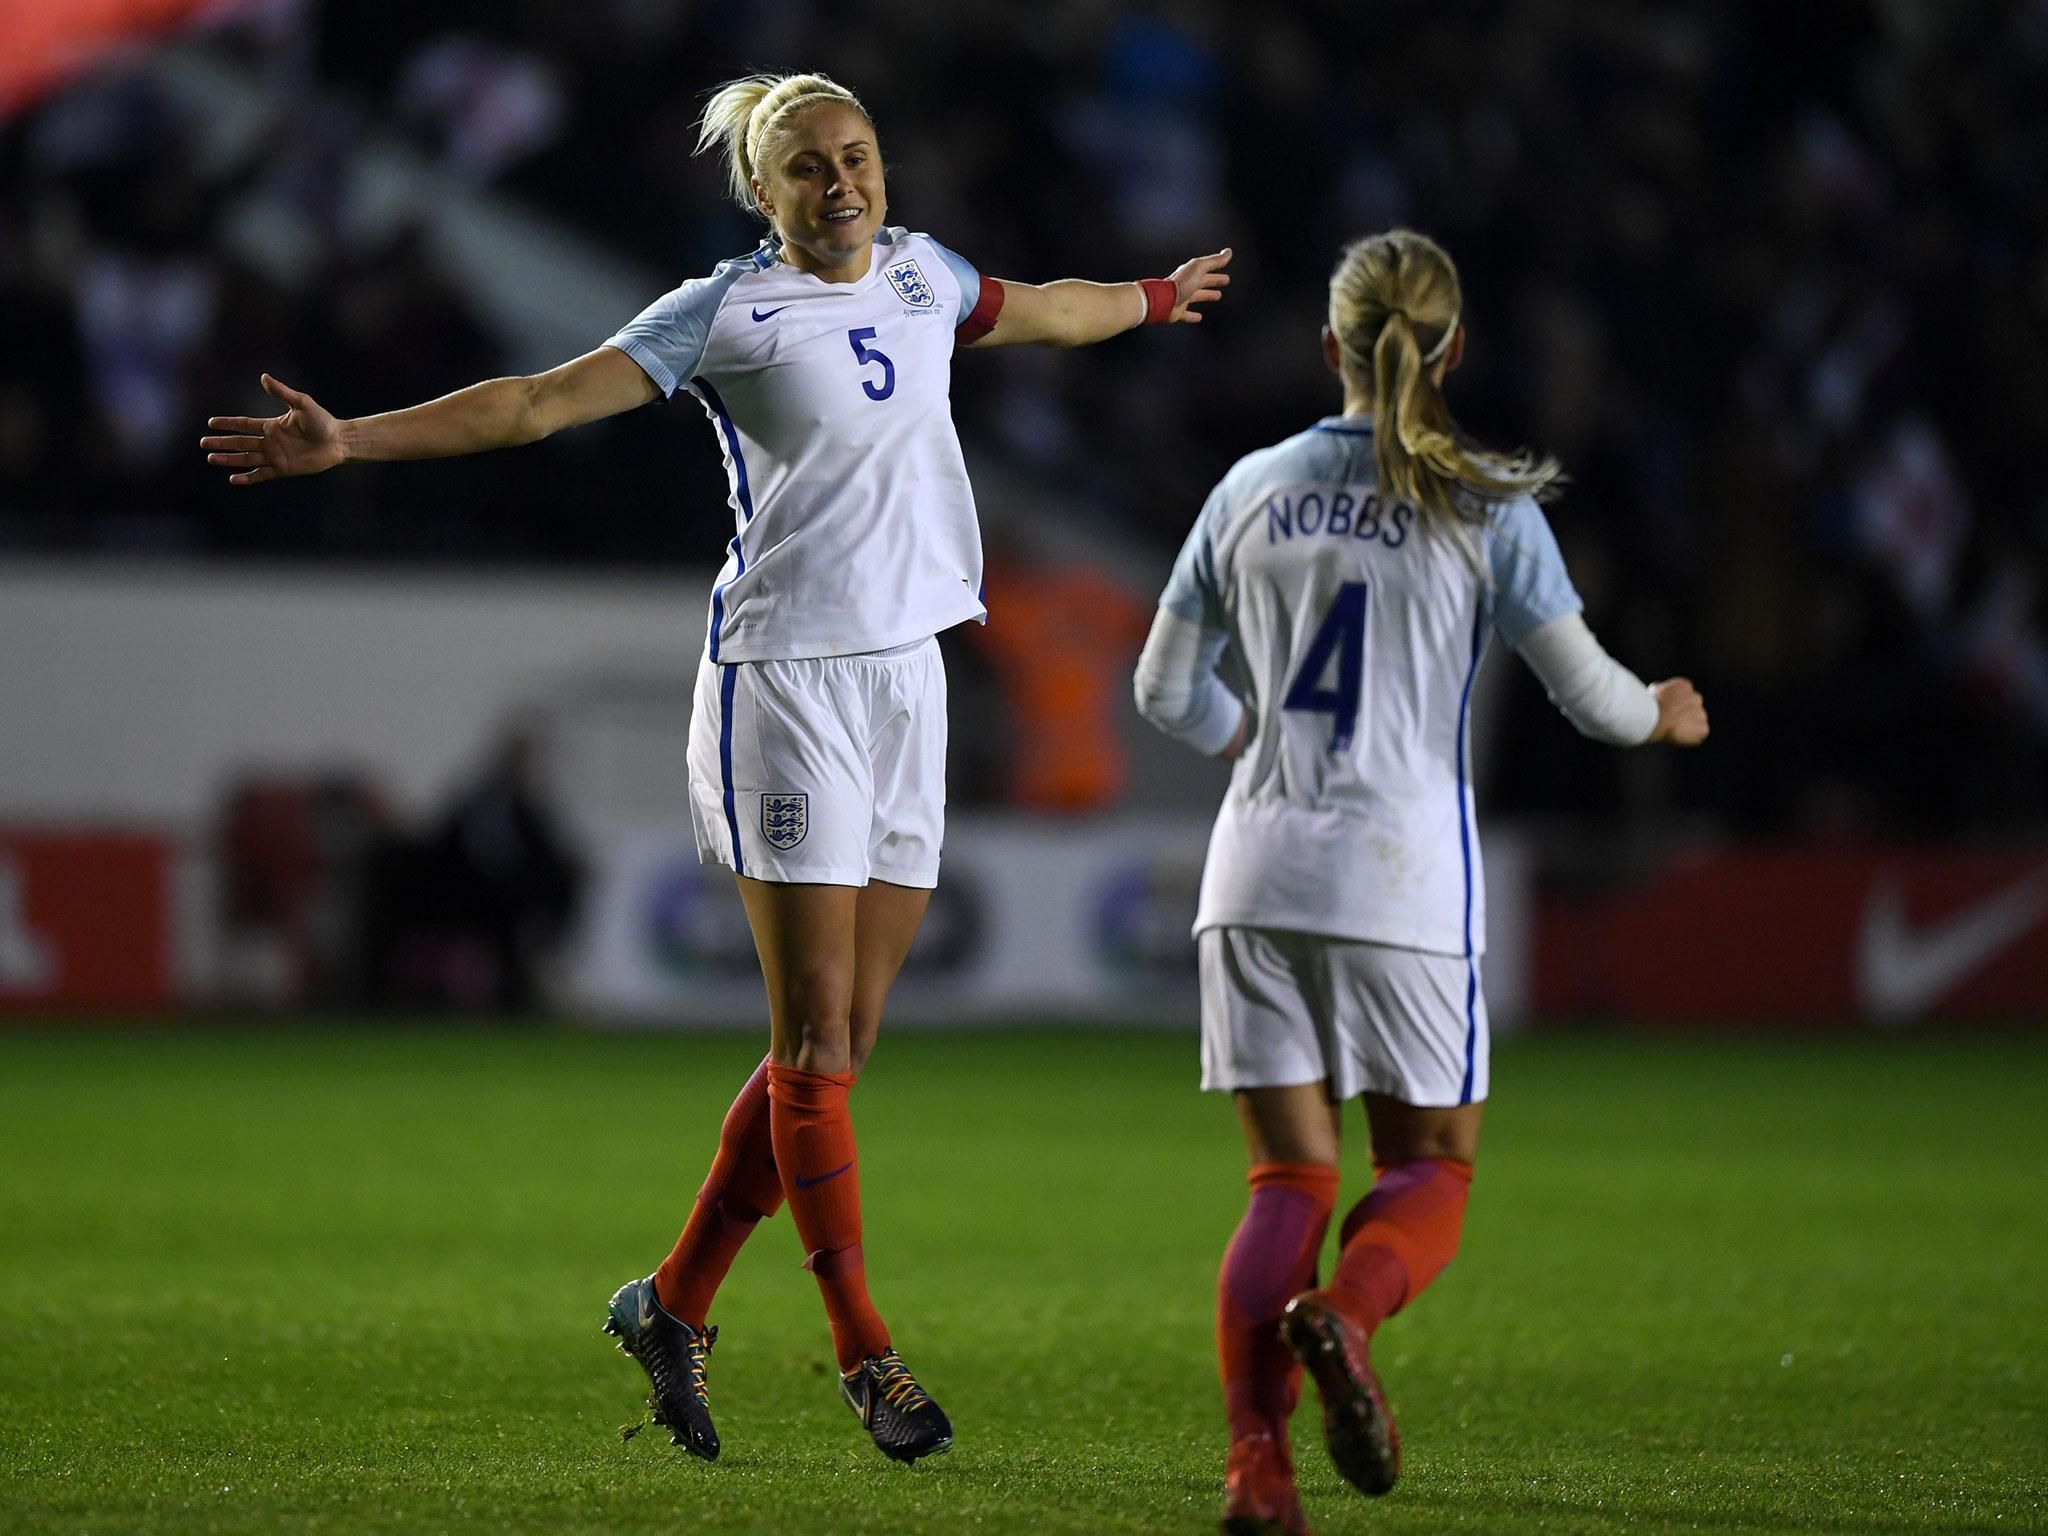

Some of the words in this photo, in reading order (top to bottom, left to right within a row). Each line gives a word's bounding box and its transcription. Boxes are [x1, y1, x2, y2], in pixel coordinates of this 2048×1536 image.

[848, 326, 896, 402] 5
[1267, 492, 1416, 549] NOBBS
[1283, 580, 1368, 752] 4
